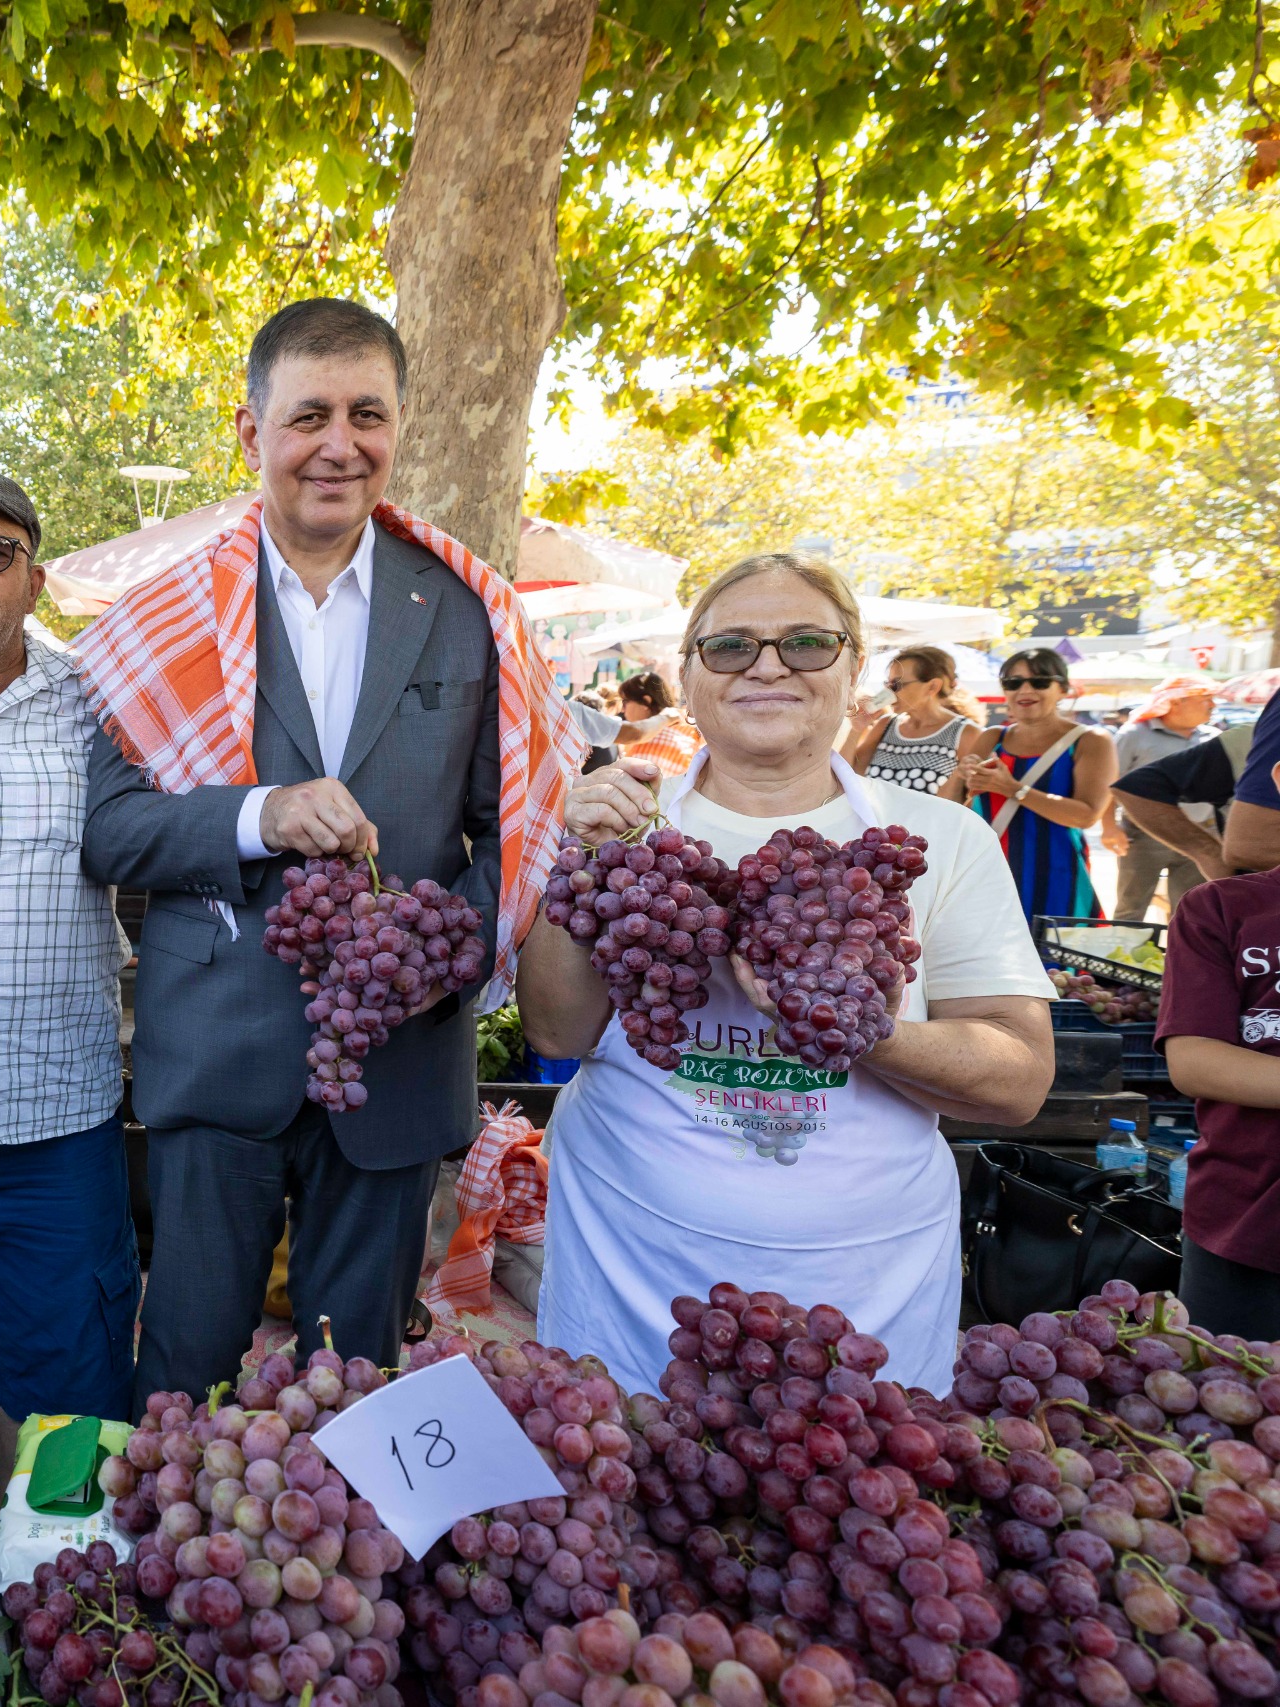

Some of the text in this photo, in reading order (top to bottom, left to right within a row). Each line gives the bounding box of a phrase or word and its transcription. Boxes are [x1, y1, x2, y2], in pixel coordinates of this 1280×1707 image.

[688, 1020, 788, 1058] URL
[679, 1059, 727, 1083] BAĞ
[695, 1088, 827, 1113] ŞENLİKLERİ
[695, 1114, 827, 1132] 14-16 AĞUSTOS 2015
[391, 1418, 456, 1491] 18
